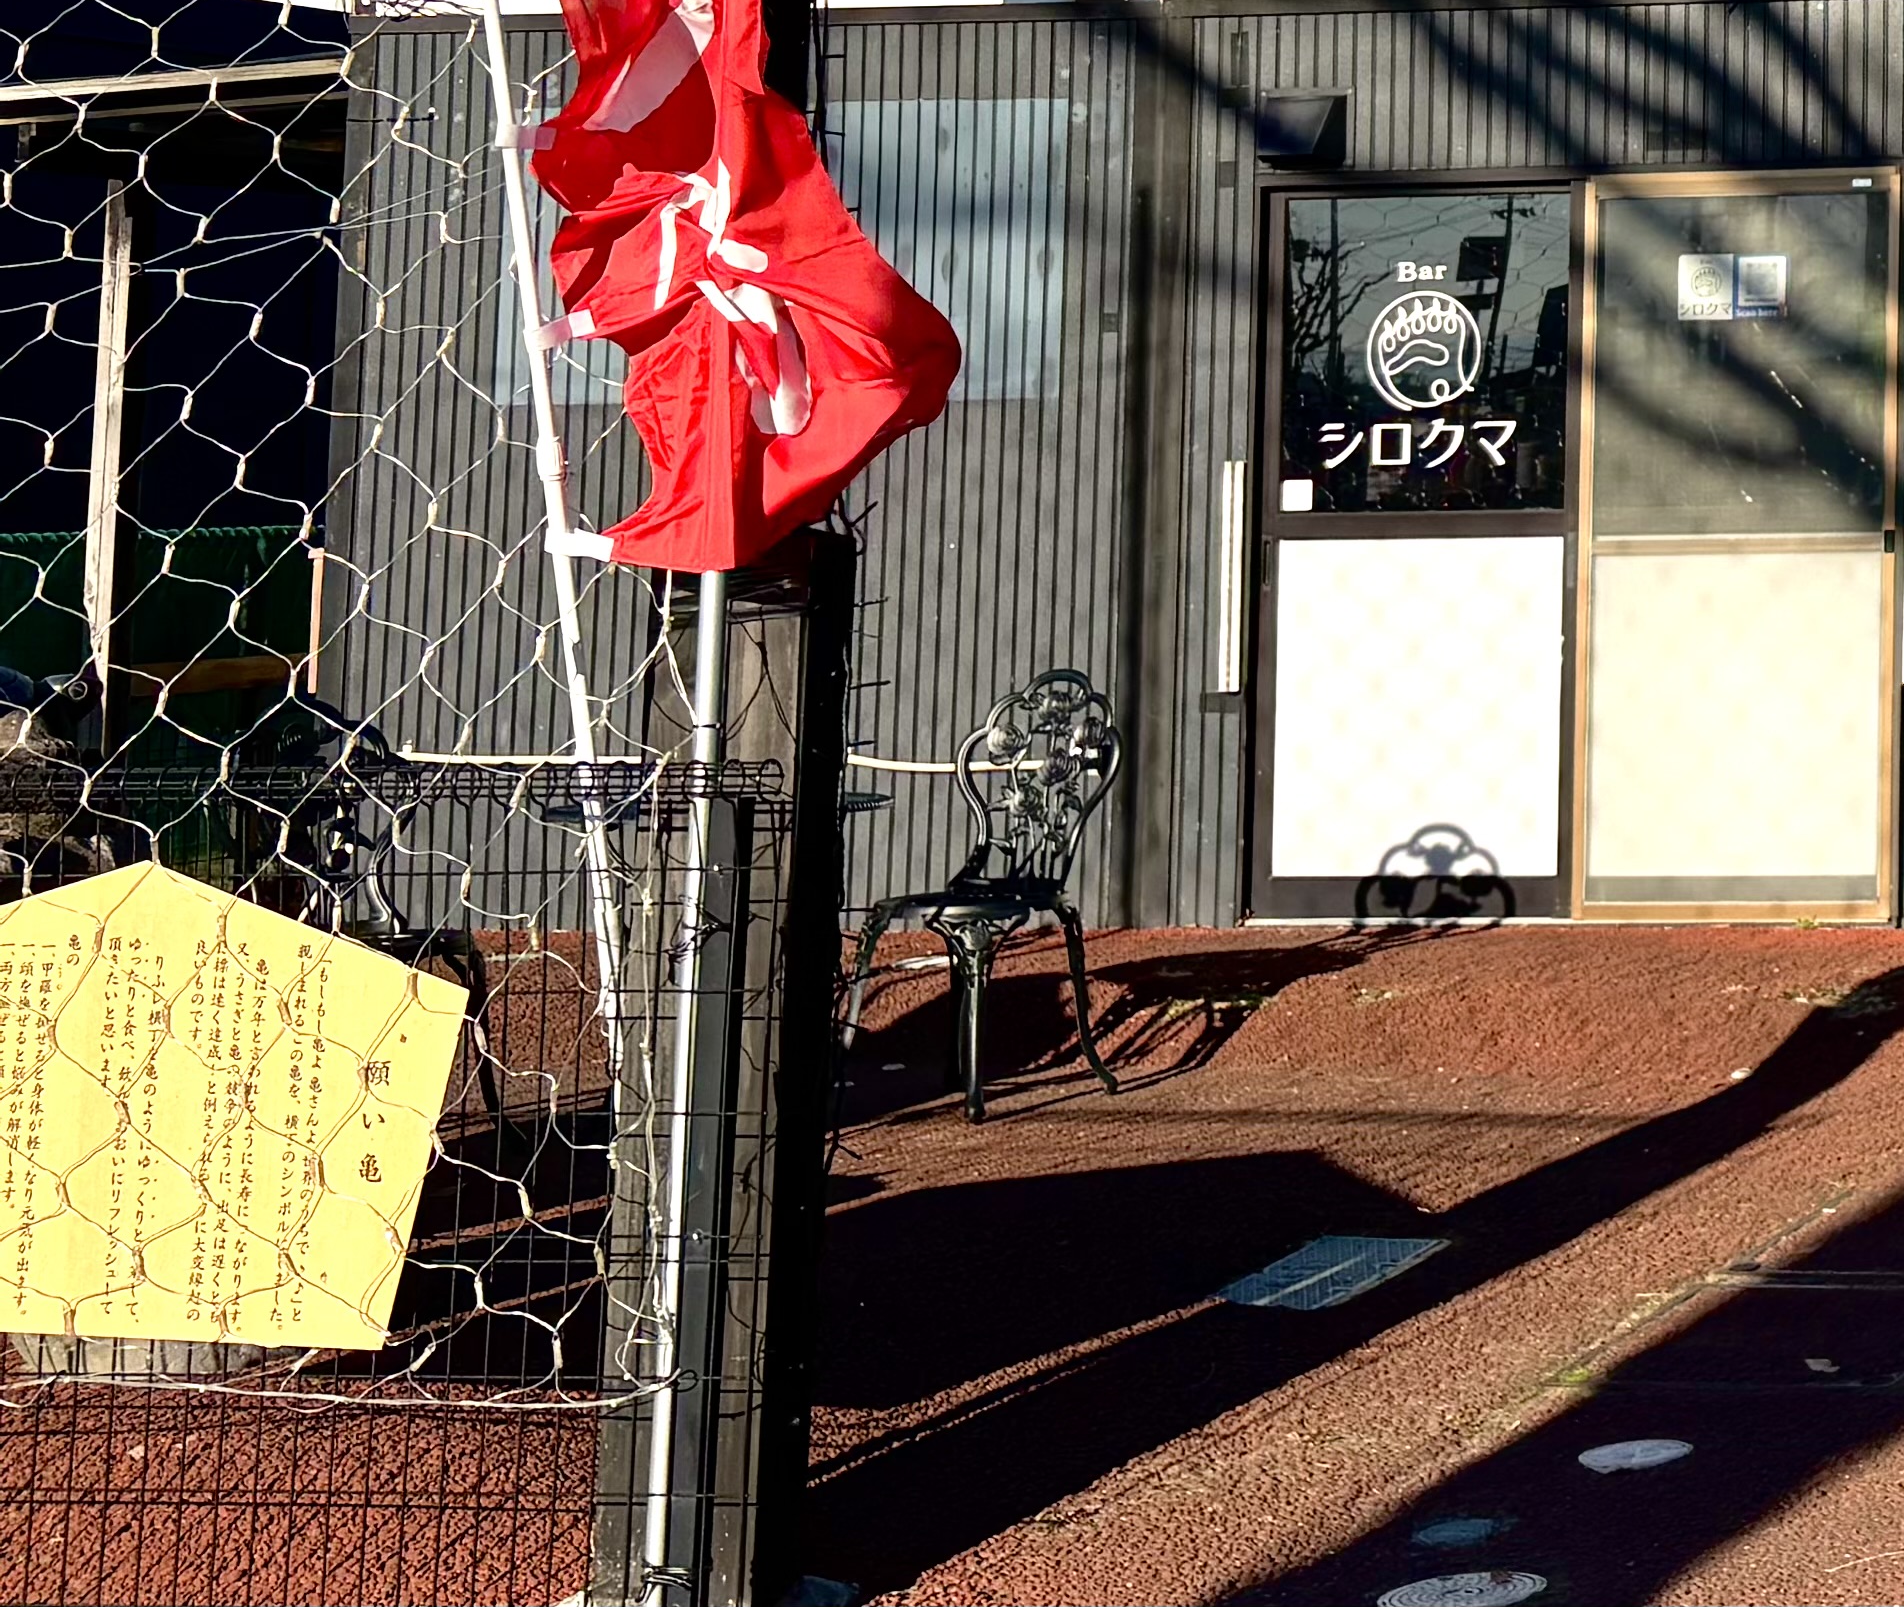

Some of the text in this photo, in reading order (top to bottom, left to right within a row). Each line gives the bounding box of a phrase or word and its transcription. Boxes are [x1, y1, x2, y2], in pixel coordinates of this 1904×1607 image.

[1397, 260, 1447, 284] Bar
[1680, 303, 1732, 316] シロクマ
[1318, 419, 1517, 469] シロクマ
[66, 934, 81, 966] 亀の
[359, 1060, 392, 1183] 願い亀
